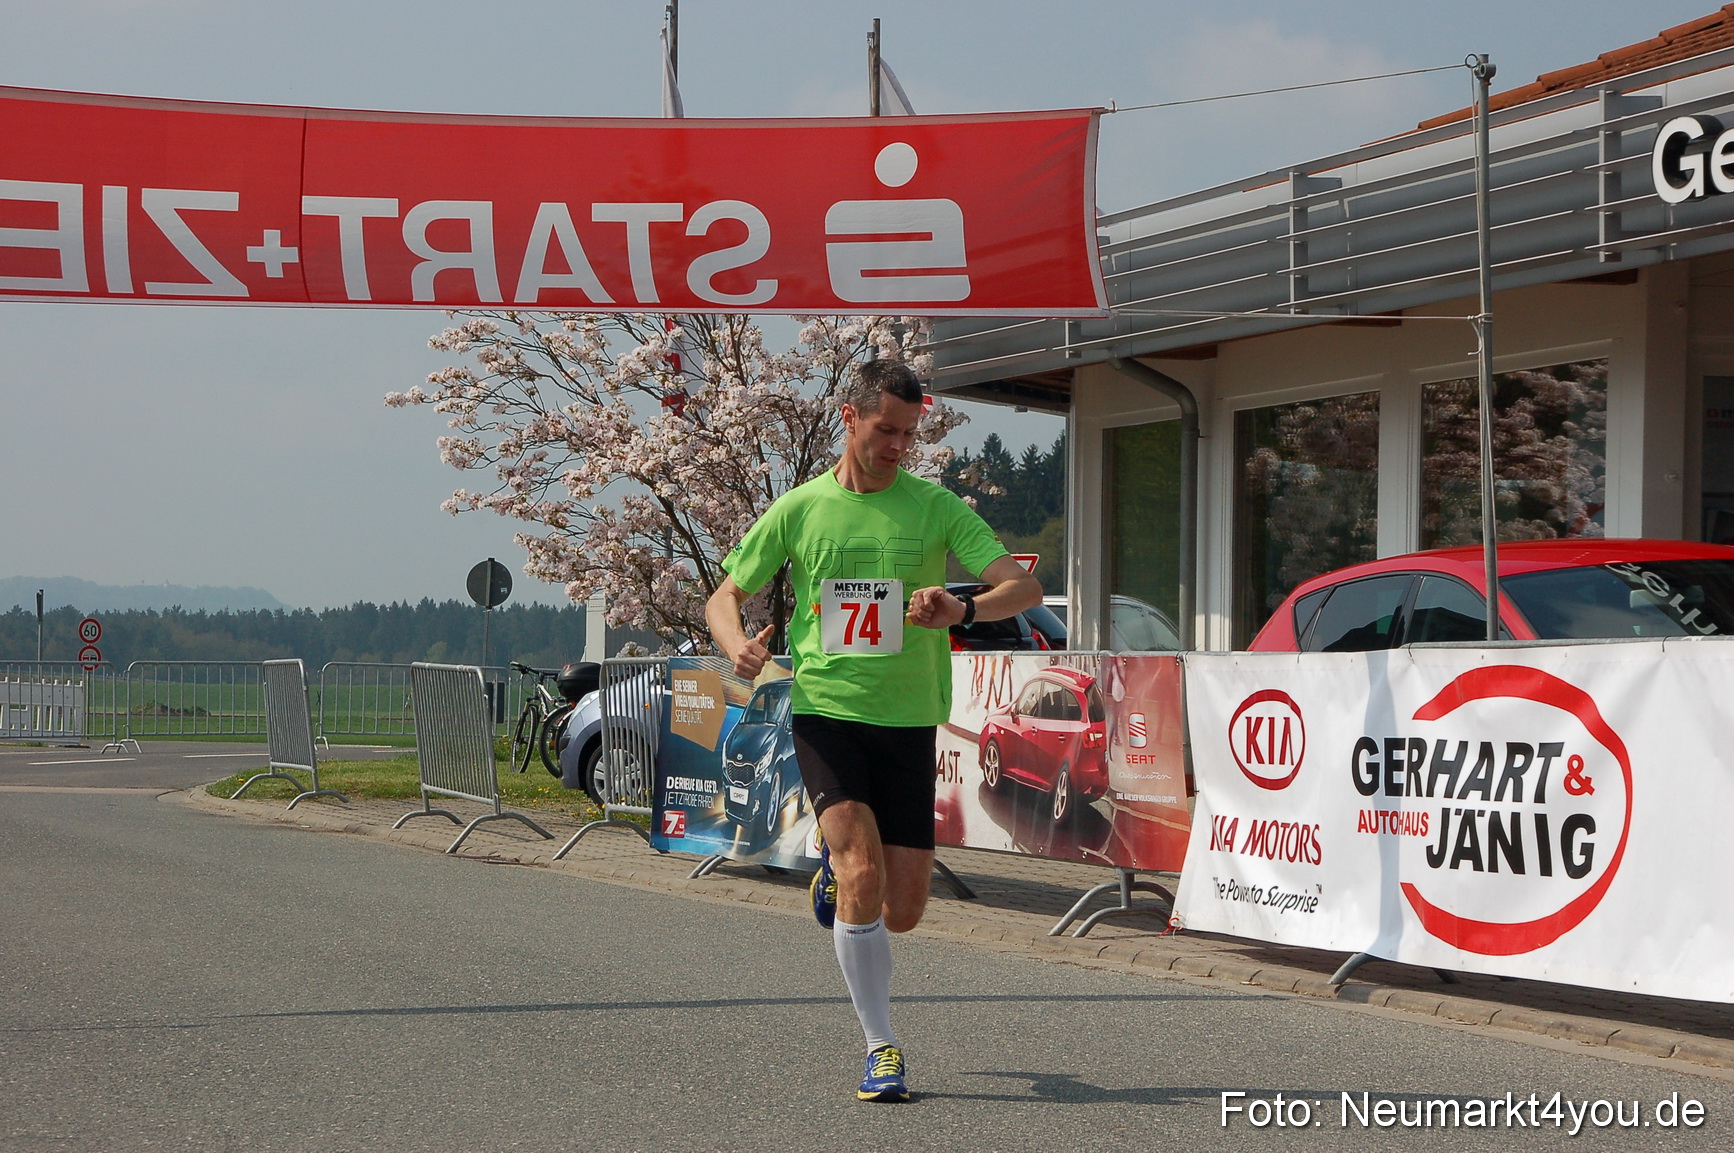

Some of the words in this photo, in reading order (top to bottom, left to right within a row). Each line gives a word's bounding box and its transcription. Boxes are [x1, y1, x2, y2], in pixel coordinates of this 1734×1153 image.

[834, 583, 872, 592] MEYER
[83, 625, 97, 637] 60
[840, 603, 882, 645] 74
[1245, 716, 1295, 766] KIA
[1126, 754, 1156, 764] SEAT
[1352, 737, 1565, 804] GERHART
[1563, 754, 1595, 795] &
[664, 813, 680, 834] 7
[1210, 814, 1239, 852] KIA
[1240, 819, 1322, 866] MOTORS
[1358, 810, 1428, 837] AUTOHAUS
[1426, 808, 1597, 879] JÄNIG
